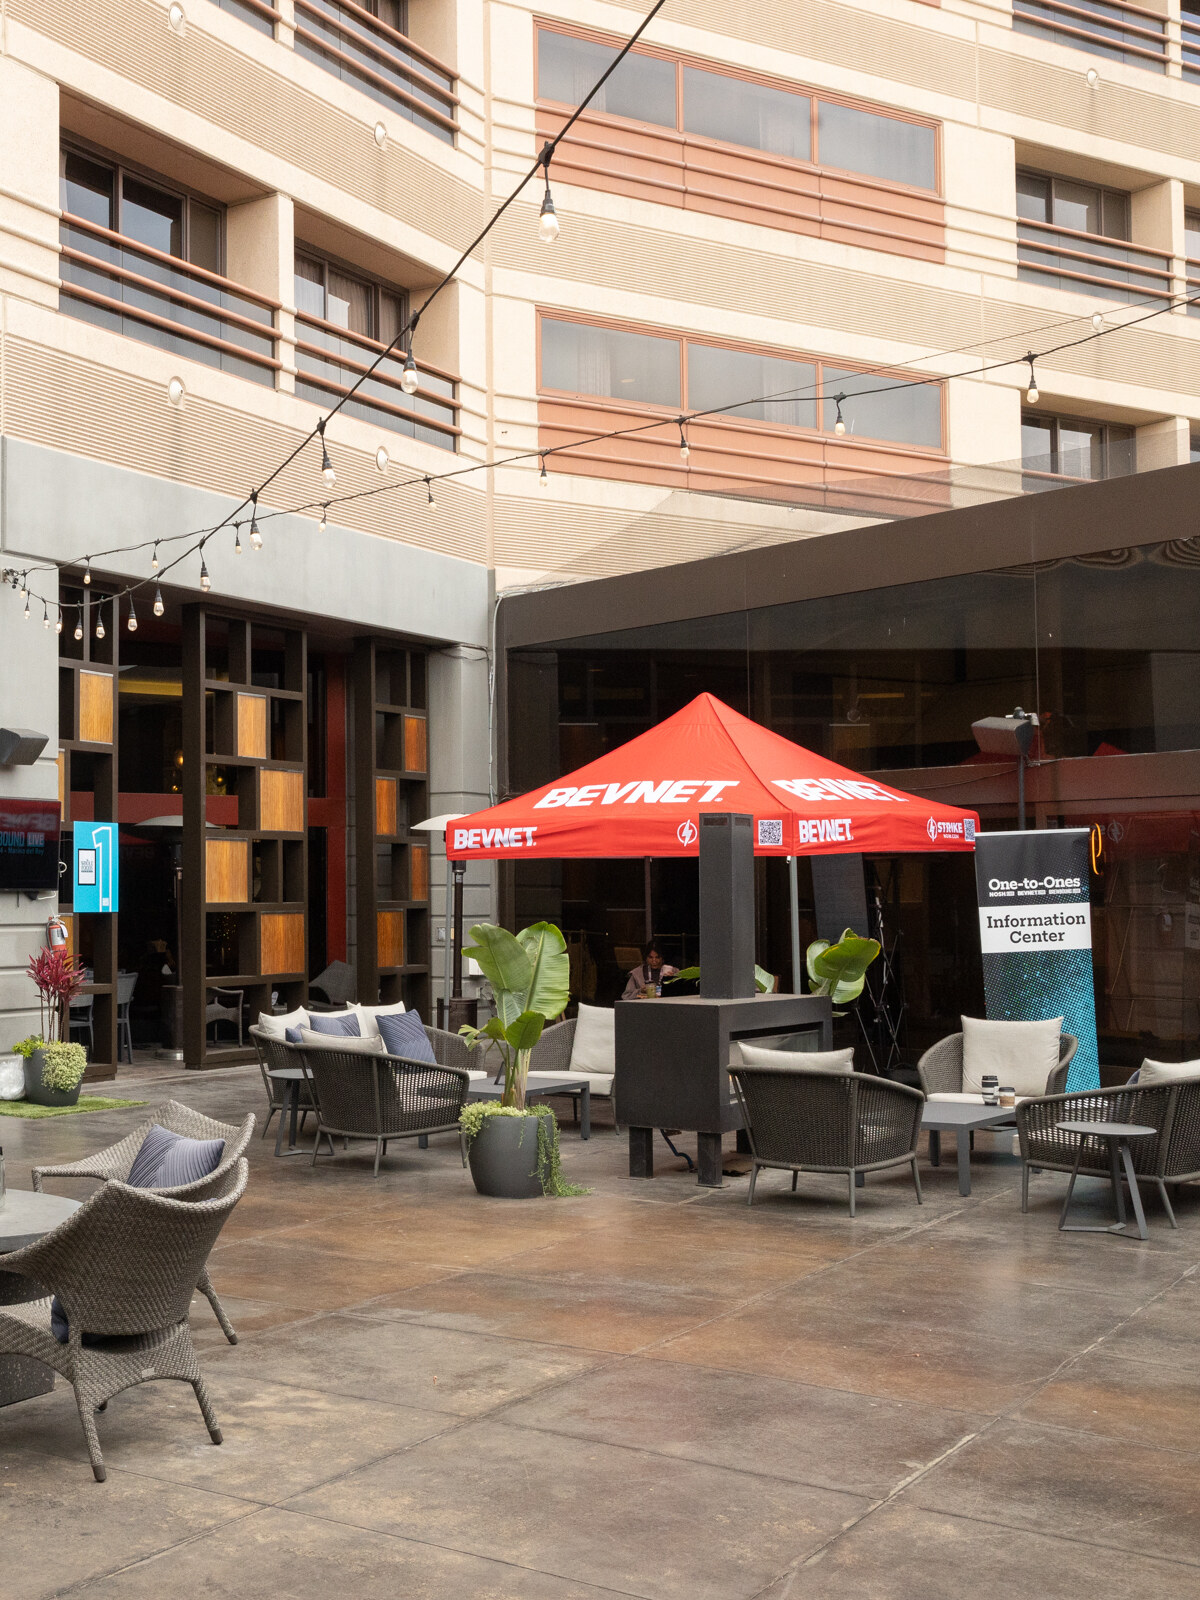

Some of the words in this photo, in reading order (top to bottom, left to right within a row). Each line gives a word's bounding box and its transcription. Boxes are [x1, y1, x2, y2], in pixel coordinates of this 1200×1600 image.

[533, 780, 740, 809] BEVNET
[771, 778, 907, 802] BEVNET
[799, 818, 853, 844] BEVNET
[937, 822, 963, 833] STRIKE
[29, 833, 44, 846] LIVE
[454, 826, 537, 850] BEVNET
[91, 826, 112, 912] 1
[988, 876, 1081, 891] One-to-Ones
[986, 912, 1086, 929] Information
[1009, 930, 1066, 944] Center
